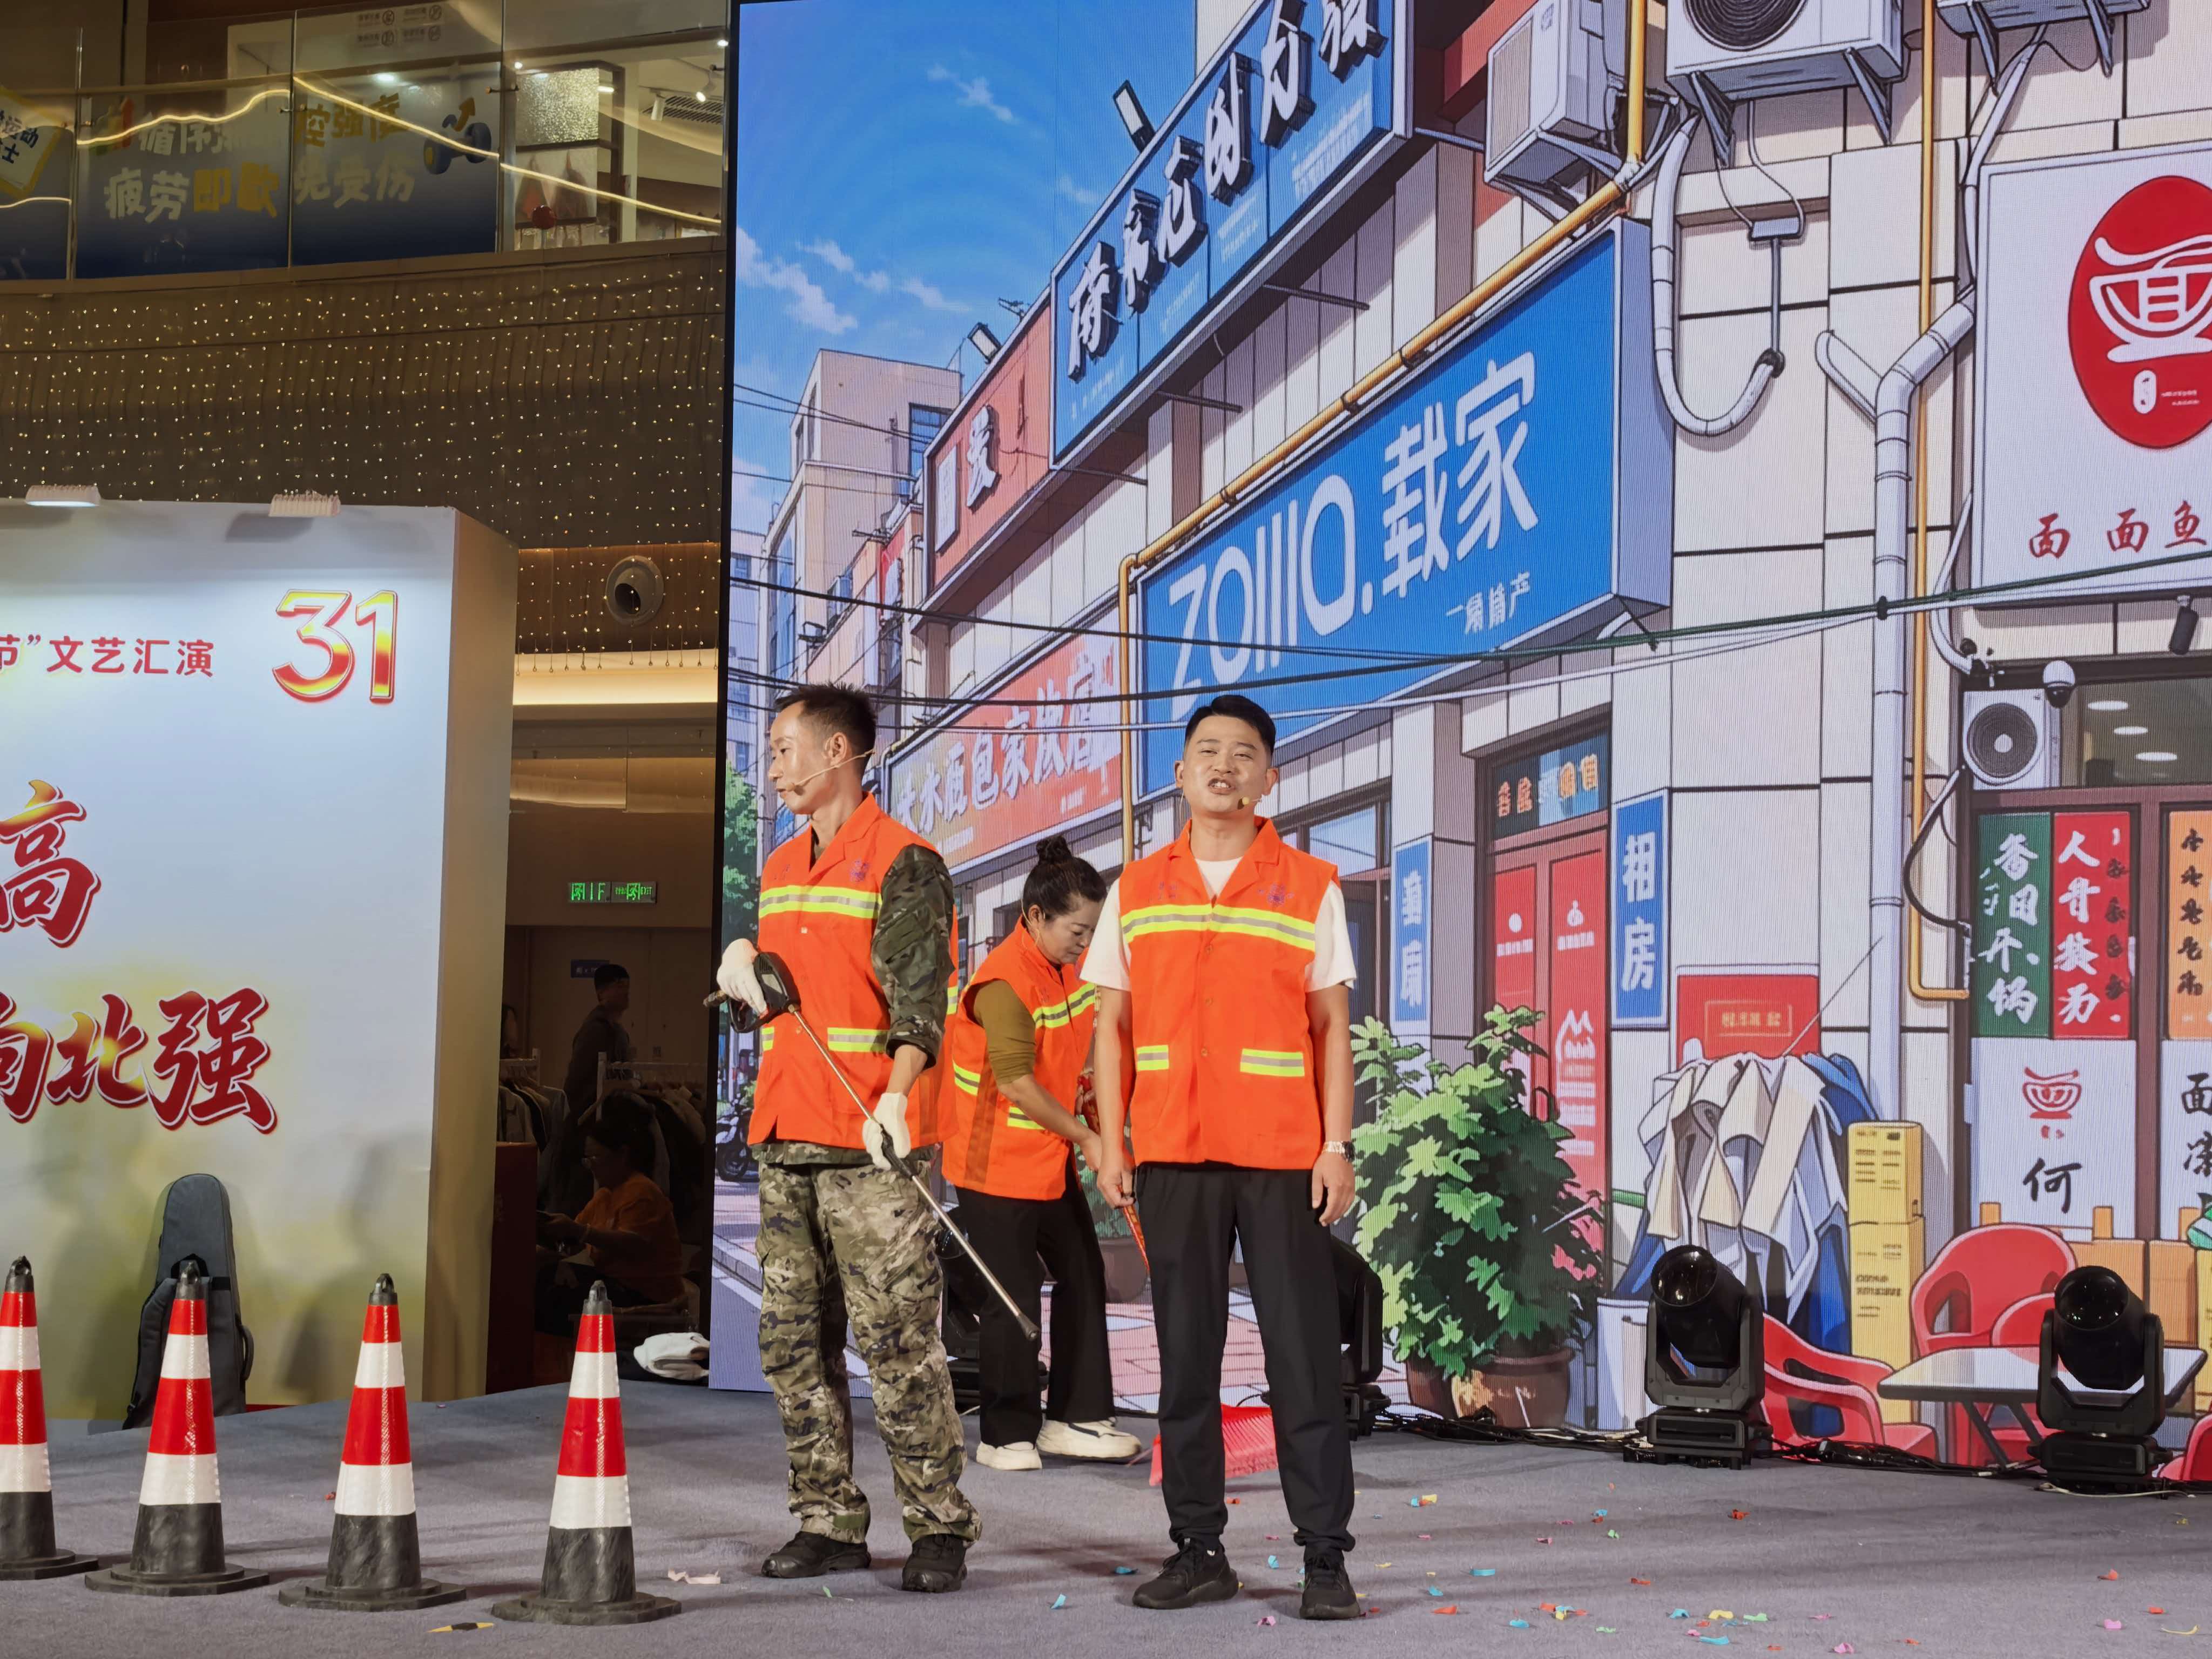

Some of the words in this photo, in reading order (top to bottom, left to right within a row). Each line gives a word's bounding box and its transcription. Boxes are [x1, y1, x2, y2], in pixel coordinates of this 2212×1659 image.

[2029, 500, 2208, 559] 面面鱼
[272, 589, 398, 704] 31
[0, 780, 101, 948] 高
[2022, 1157, 2082, 1214] 何
